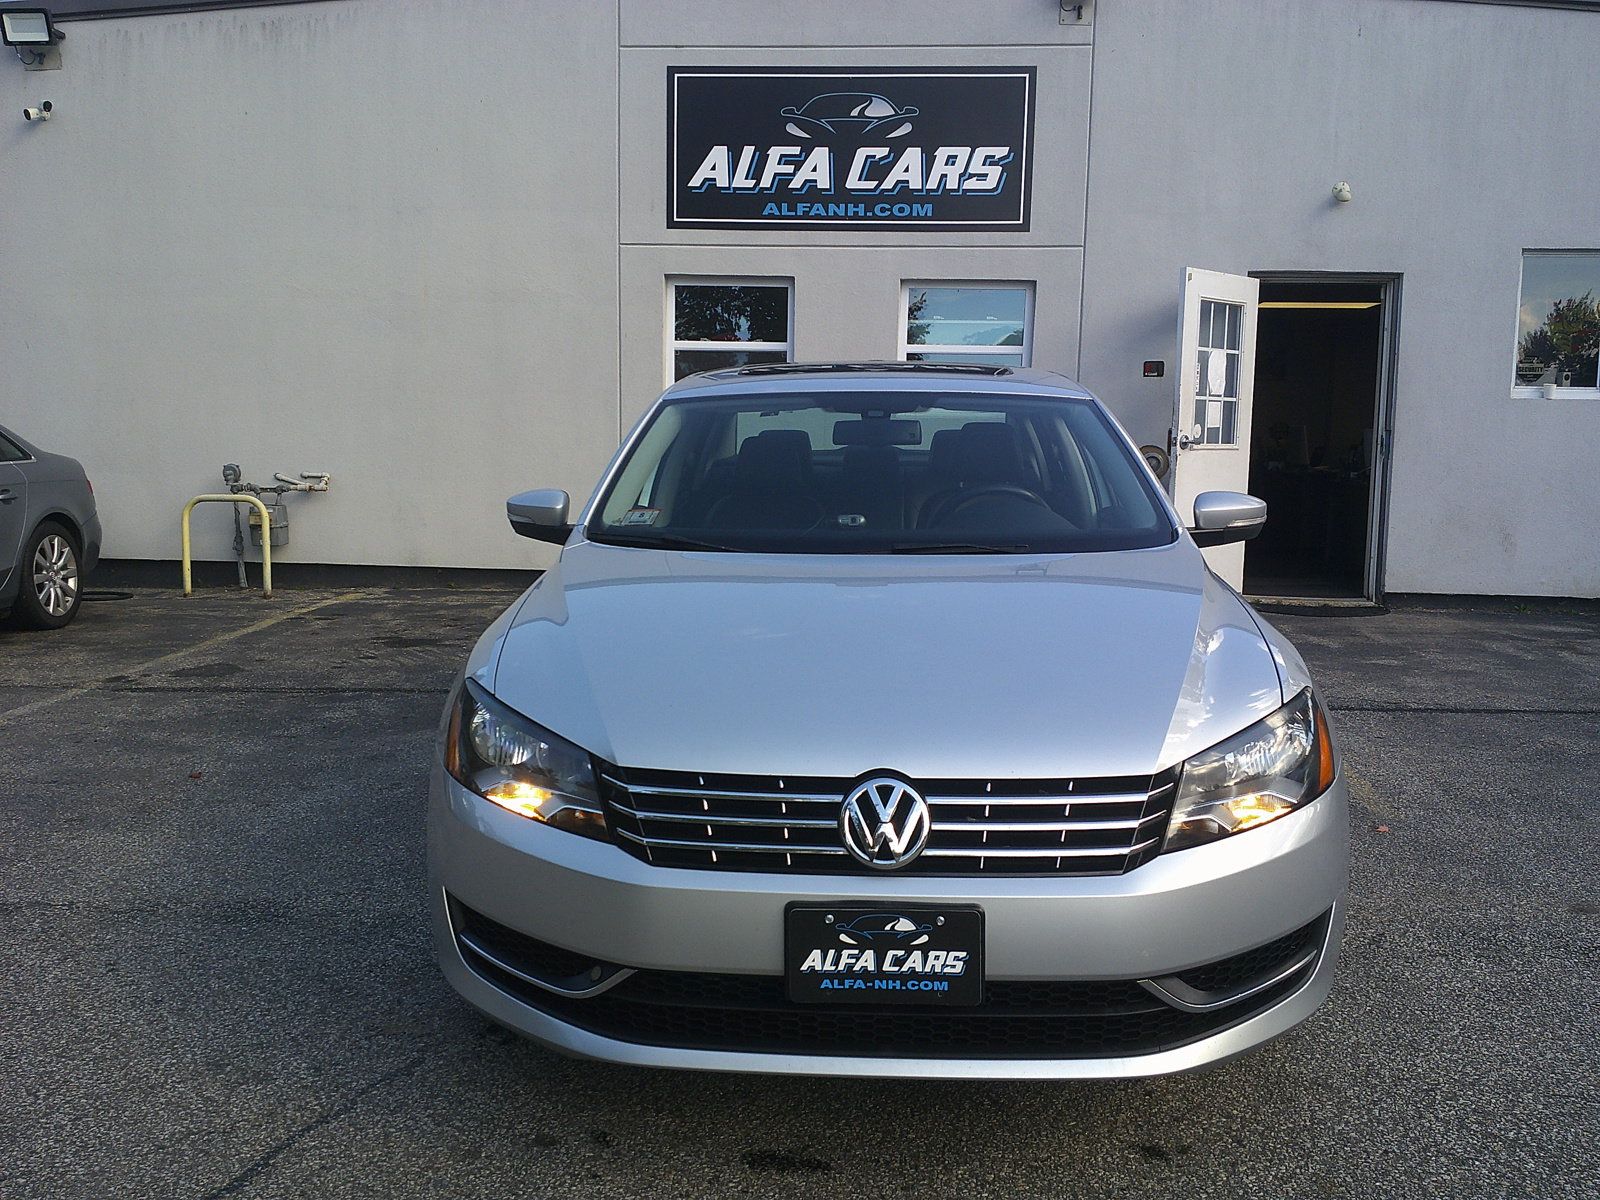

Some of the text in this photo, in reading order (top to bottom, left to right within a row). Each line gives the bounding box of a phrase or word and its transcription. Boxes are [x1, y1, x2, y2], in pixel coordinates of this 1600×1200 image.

[687, 145, 1014, 195] ALFA CARS
[762, 202, 933, 217] ALFANH.COM
[800, 949, 970, 976] ALFA CARS
[820, 978, 949, 991] ALFA-NH.COM
